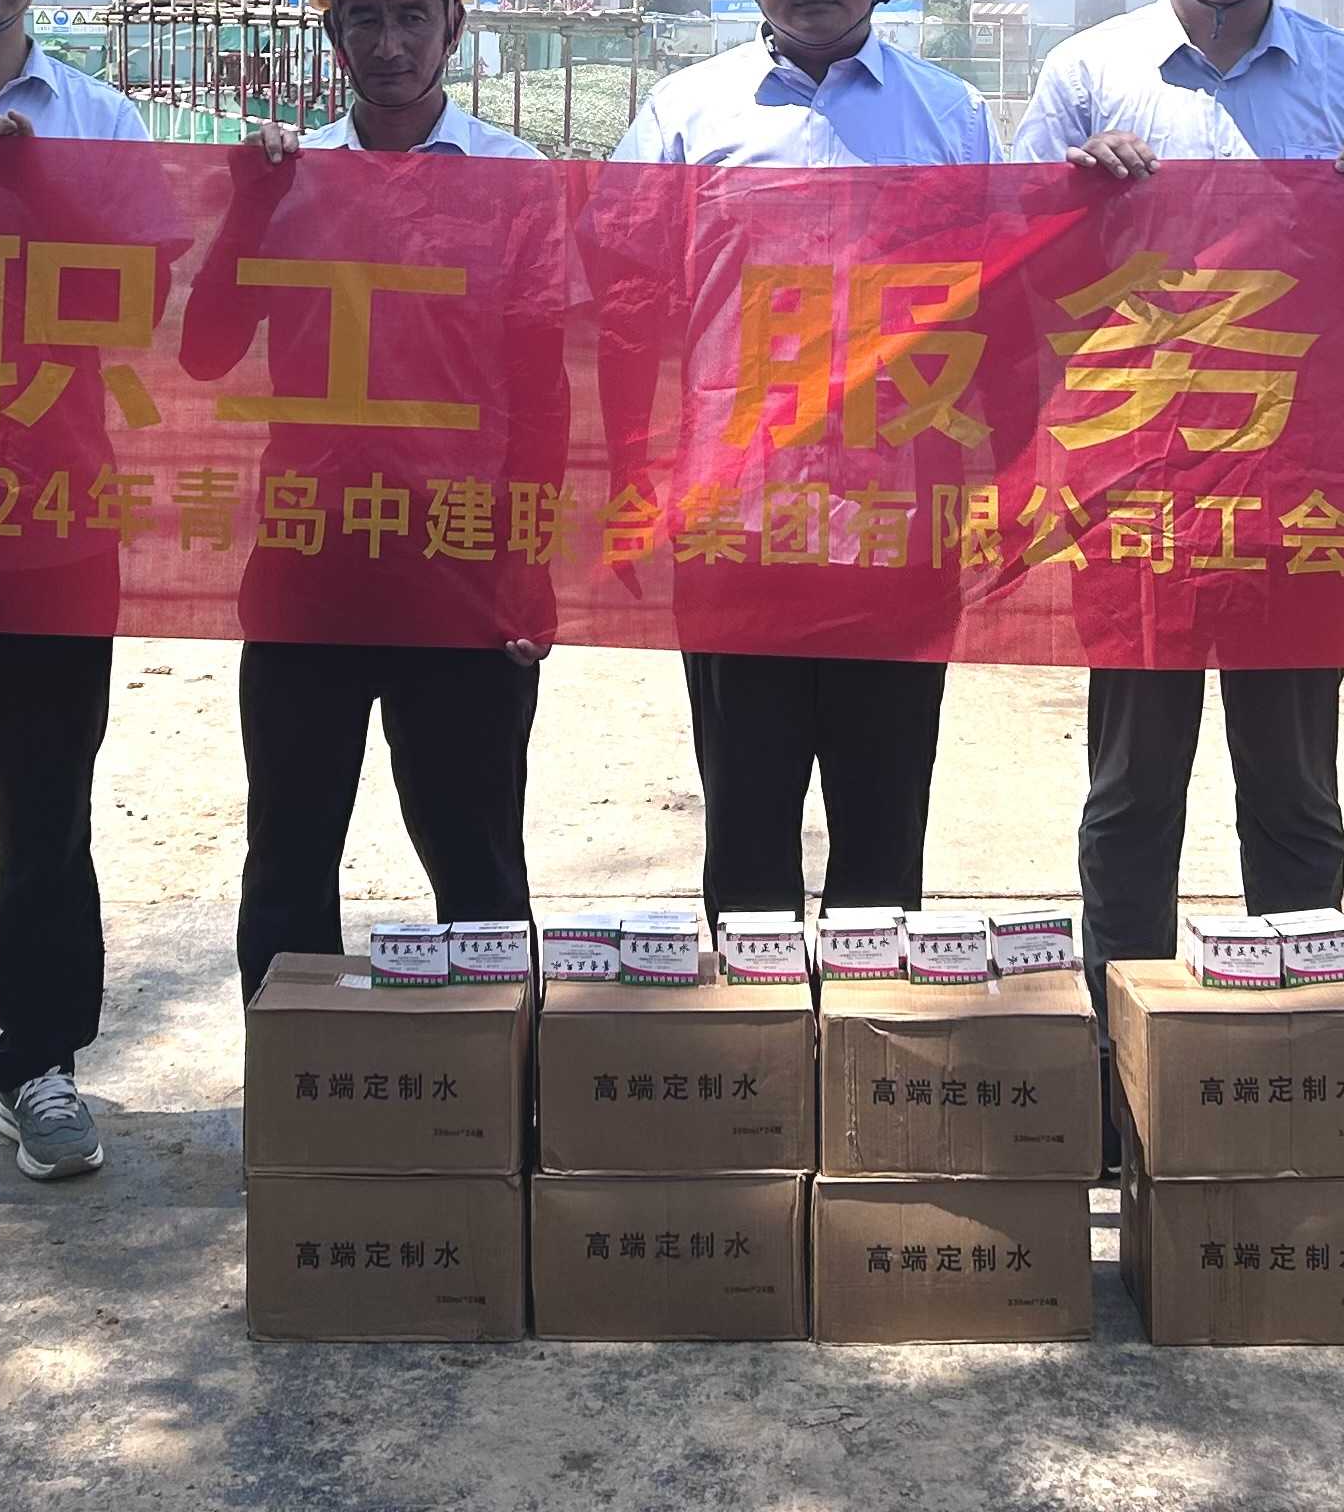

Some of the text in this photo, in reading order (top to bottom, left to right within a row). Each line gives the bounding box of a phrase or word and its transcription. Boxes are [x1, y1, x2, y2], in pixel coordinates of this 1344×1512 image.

[294, 1071, 460, 1103] 高端定制水
[592, 1073, 759, 1102] 高端定制水
[871, 1078, 1039, 1108] 高端定制水
[295, 1240, 461, 1270] 高端定制水
[585, 1231, 752, 1261] 高端定制水
[866, 1243, 1033, 1274] 高端定制水
